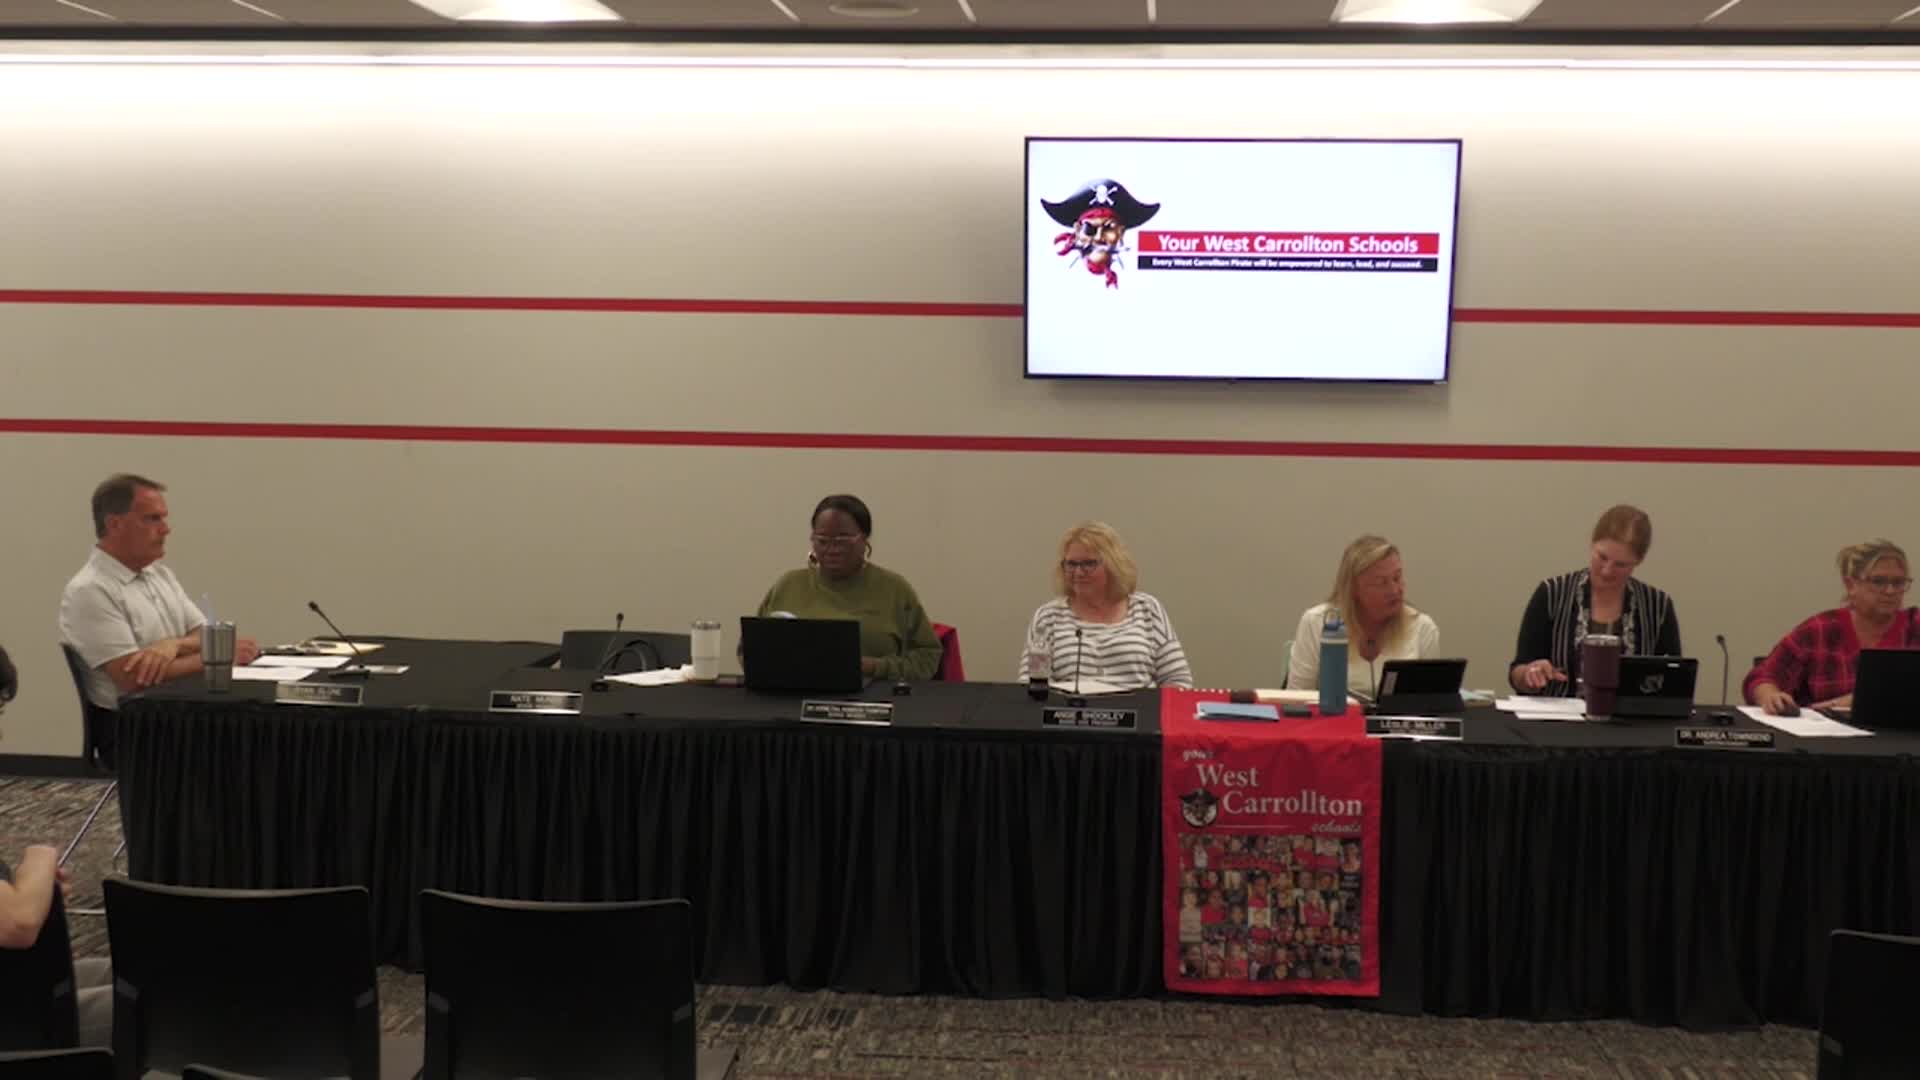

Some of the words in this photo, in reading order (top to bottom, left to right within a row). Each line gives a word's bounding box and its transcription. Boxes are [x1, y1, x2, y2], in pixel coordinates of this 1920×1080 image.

[1158, 234, 1199, 251] Your
[1203, 235, 1249, 251] West
[1254, 235, 1345, 252] Carrollton
[1348, 236, 1418, 252] Schools
[1152, 258, 1172, 267] Every
[1174, 258, 1193, 266] West
[1196, 763, 1259, 787] West
[1222, 789, 1363, 817] Carrollton
